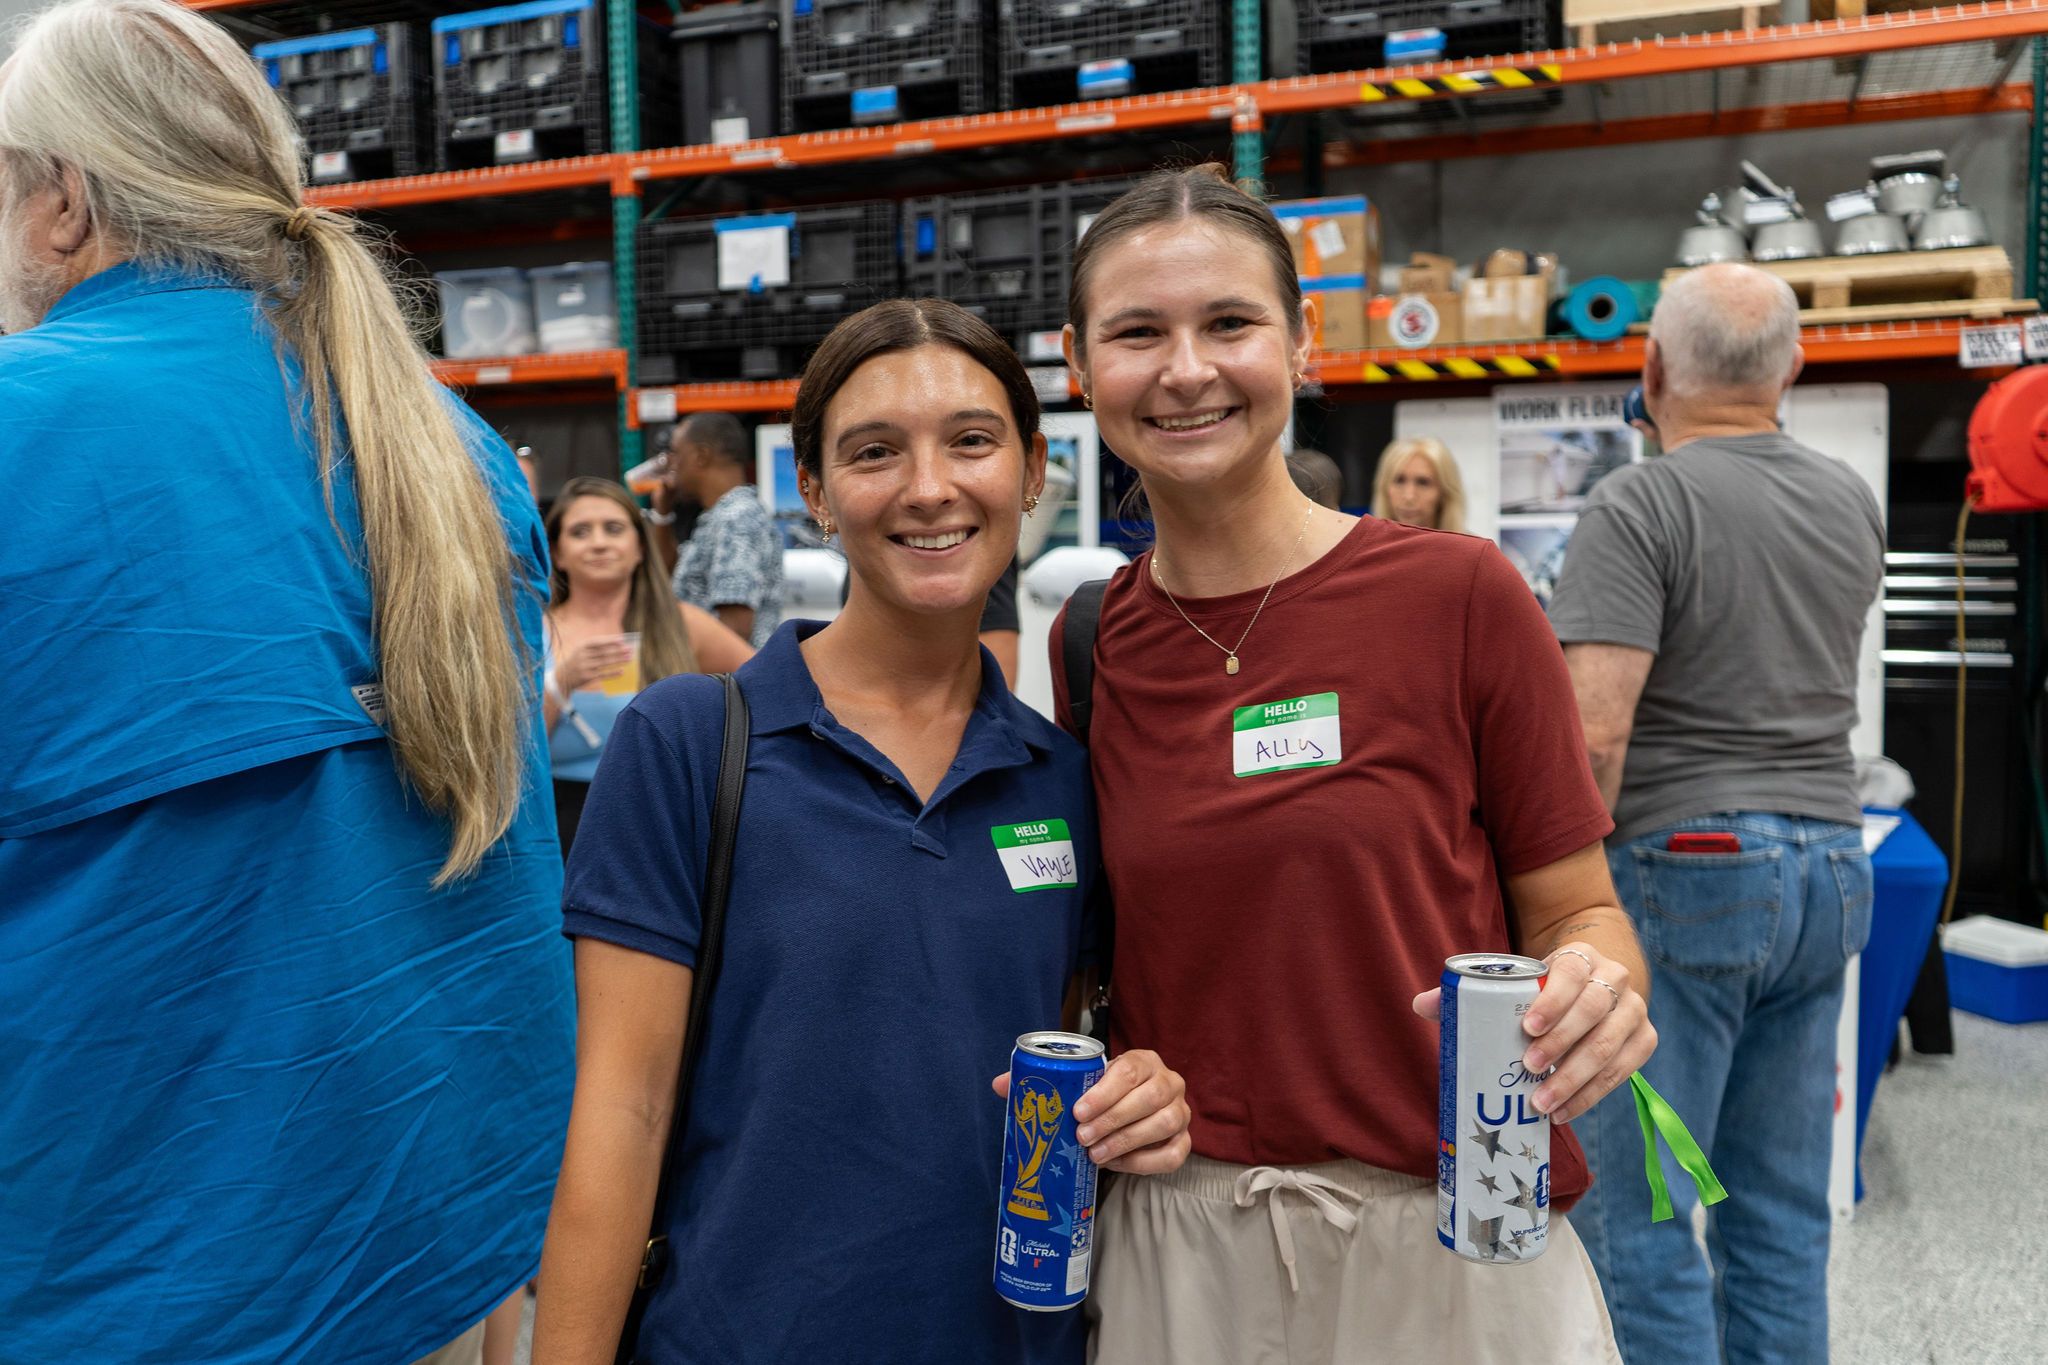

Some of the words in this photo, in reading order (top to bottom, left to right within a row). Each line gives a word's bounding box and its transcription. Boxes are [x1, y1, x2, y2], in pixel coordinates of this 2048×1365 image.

[1501, 399, 1559, 420] WORK
[1568, 396, 1624, 417] FLOA
[1264, 700, 1307, 718] HELLO
[1277, 715, 1297, 723] name
[1013, 823, 1049, 838] HELLO
